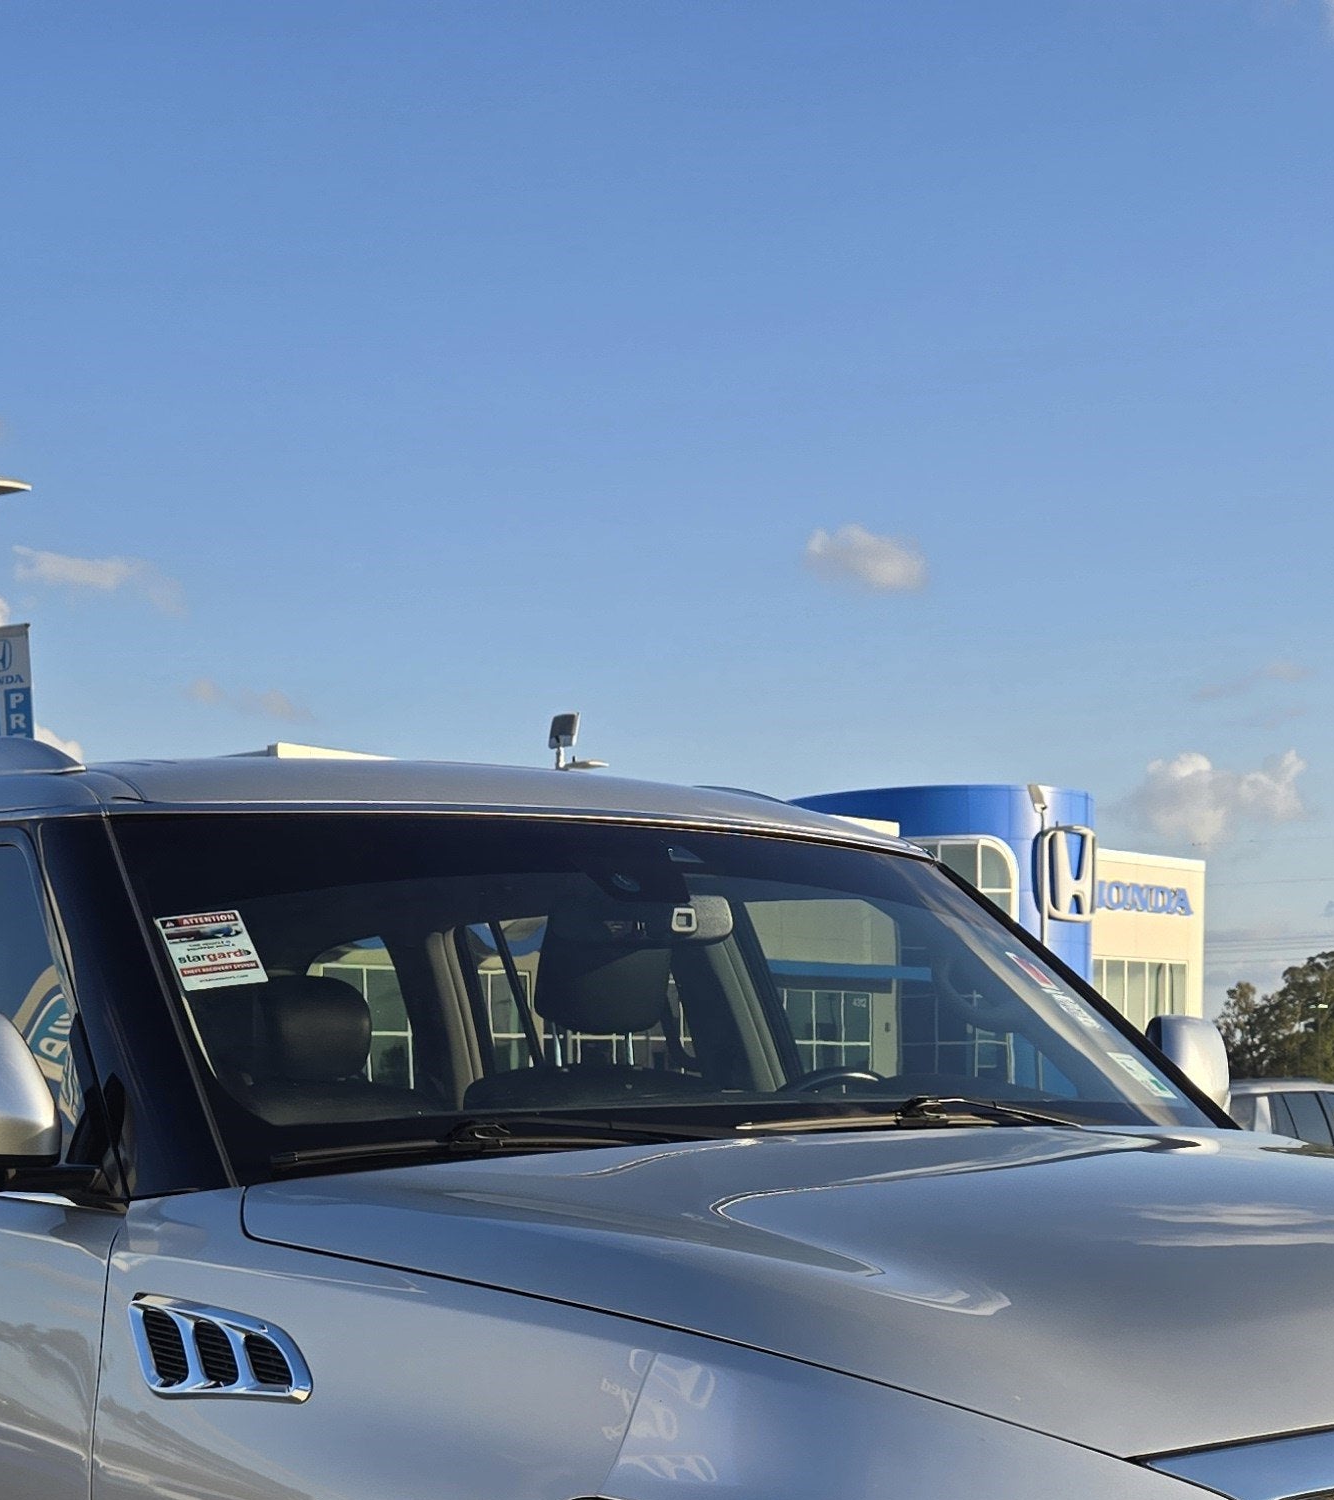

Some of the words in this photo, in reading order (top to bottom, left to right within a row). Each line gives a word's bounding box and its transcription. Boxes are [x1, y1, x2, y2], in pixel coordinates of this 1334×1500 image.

[9, 691, 28, 738] PR
[182, 912, 236, 926] ATTENTION
[177, 948, 246, 965] stargard
